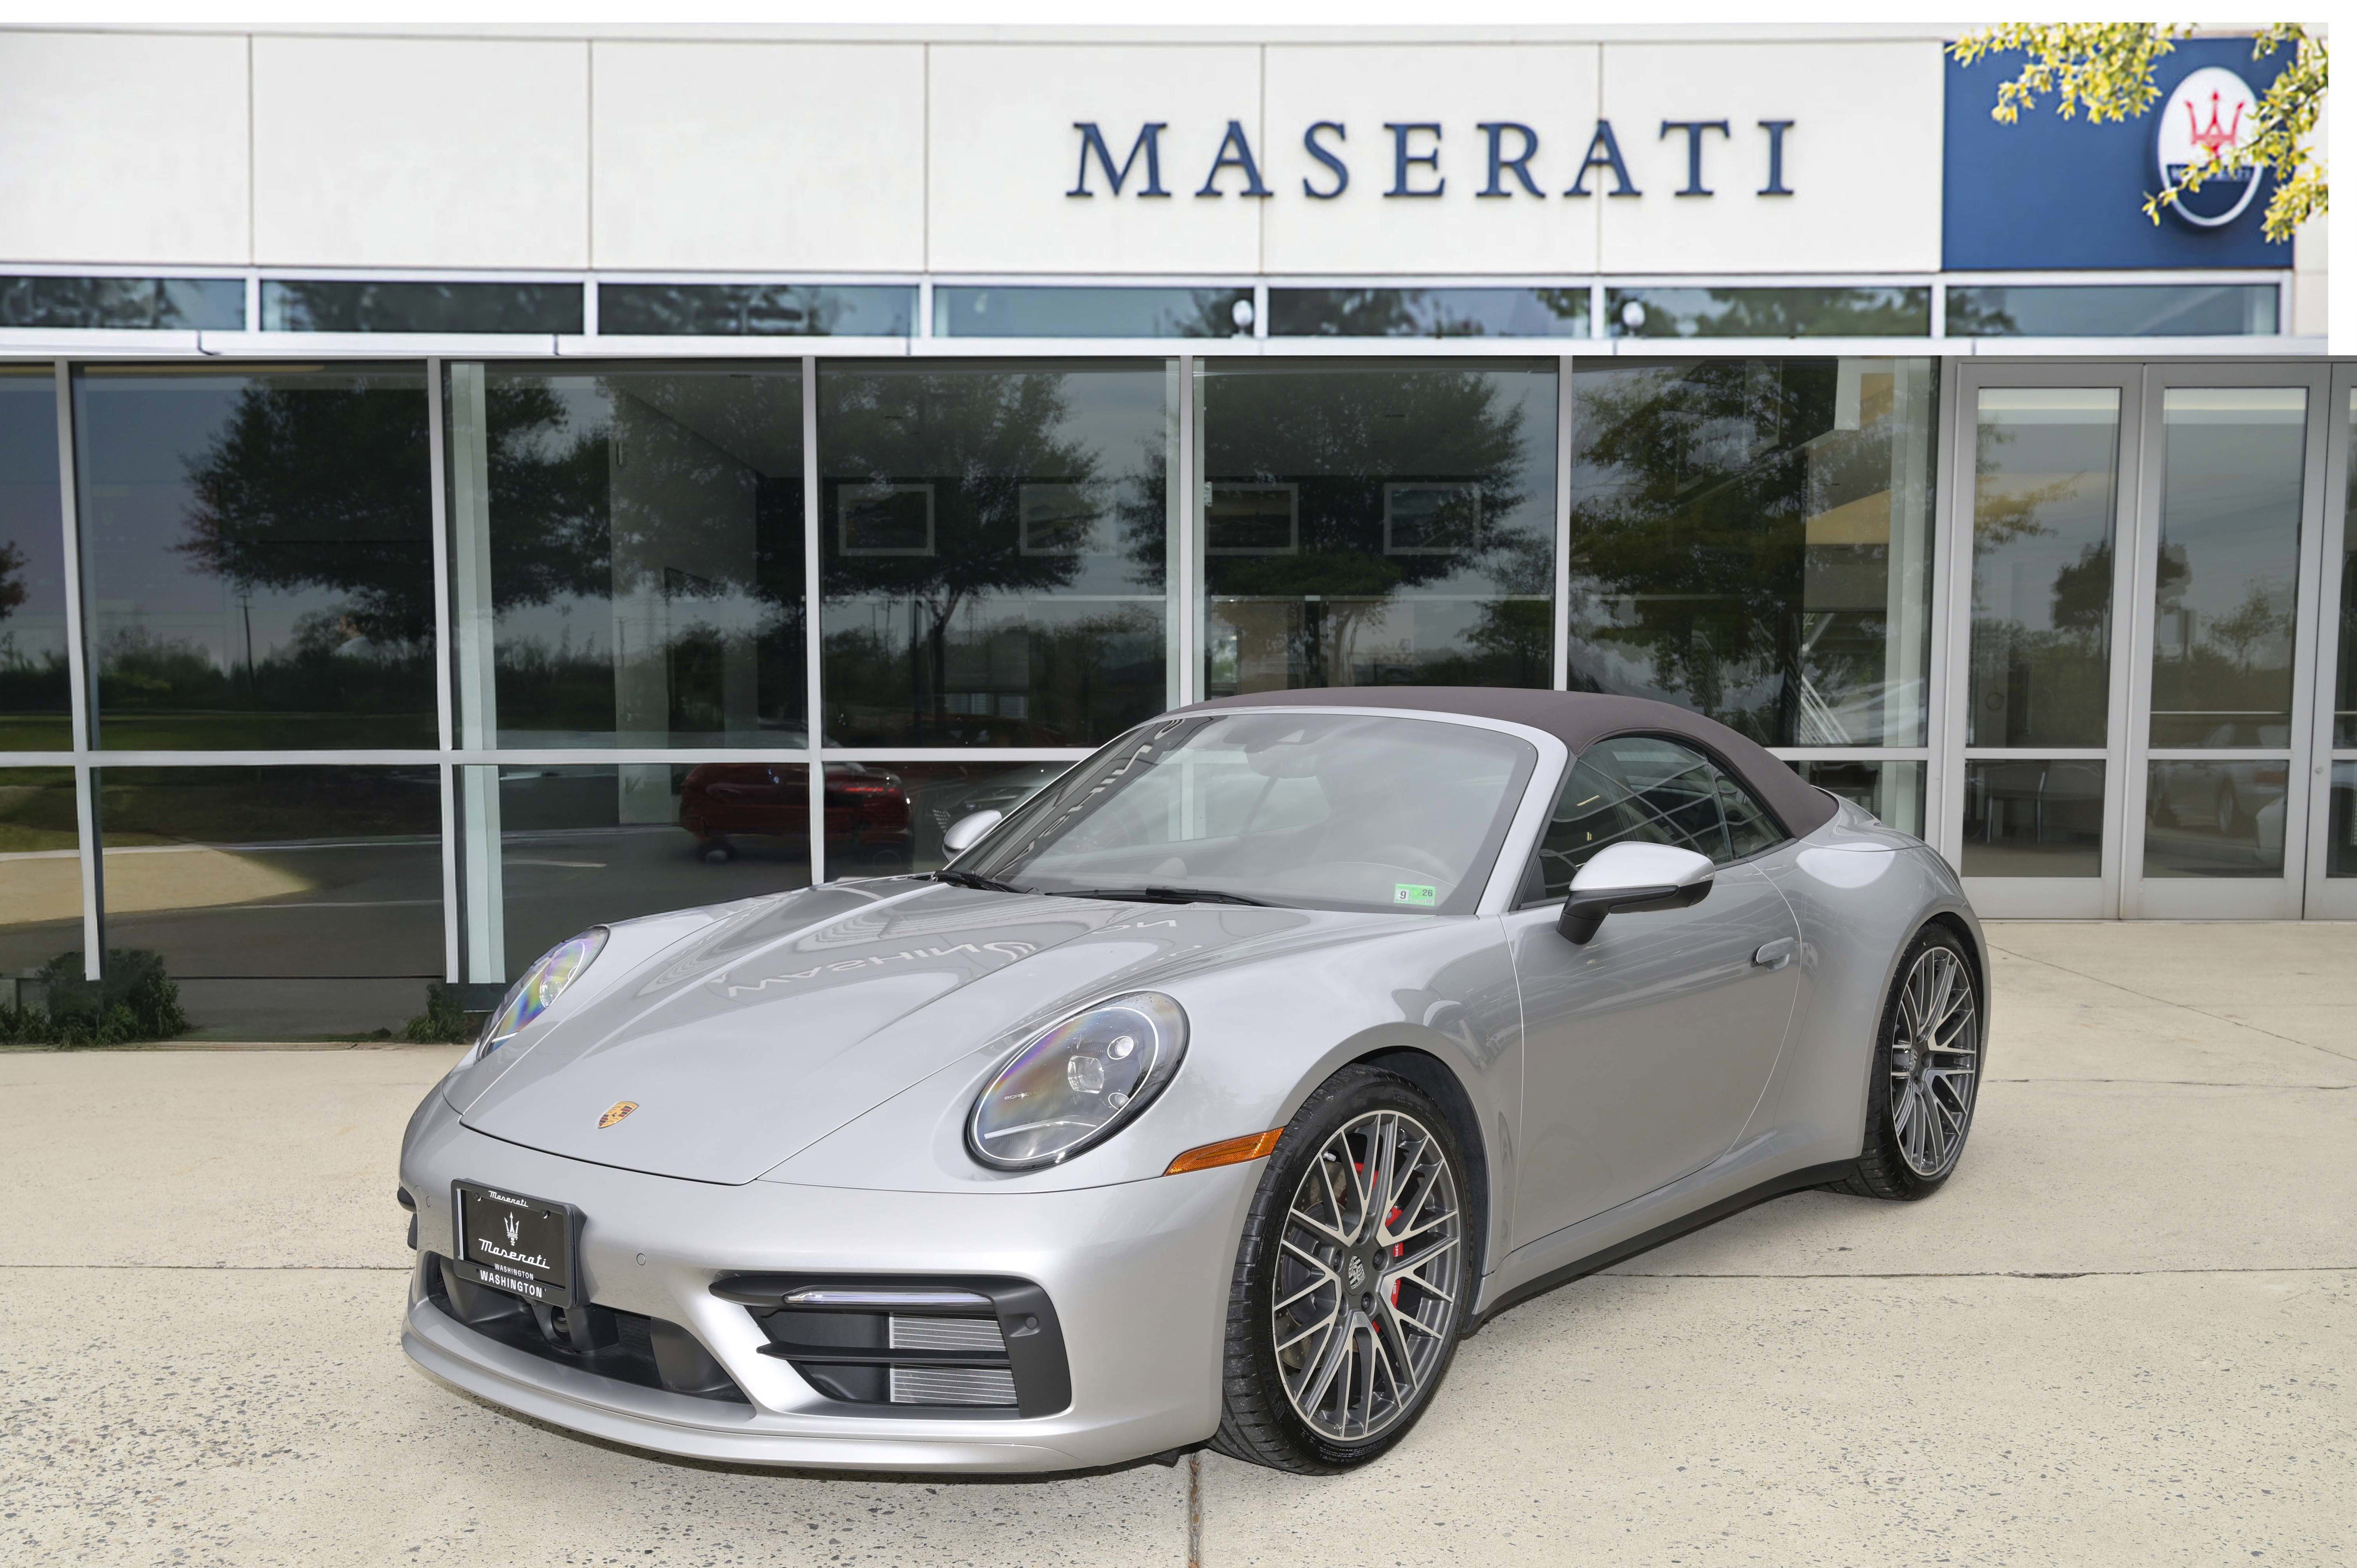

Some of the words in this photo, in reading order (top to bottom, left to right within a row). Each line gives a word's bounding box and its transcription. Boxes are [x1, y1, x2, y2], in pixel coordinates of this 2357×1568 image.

[1066, 119, 1795, 198] MASERATI
[1399, 891, 1406, 899] 9
[488, 1190, 529, 1208] Maserati
[478, 1238, 550, 1269] Maserati
[494, 1263, 534, 1280] WASHINGTON
[480, 1269, 542, 1298] WASHINGTON
